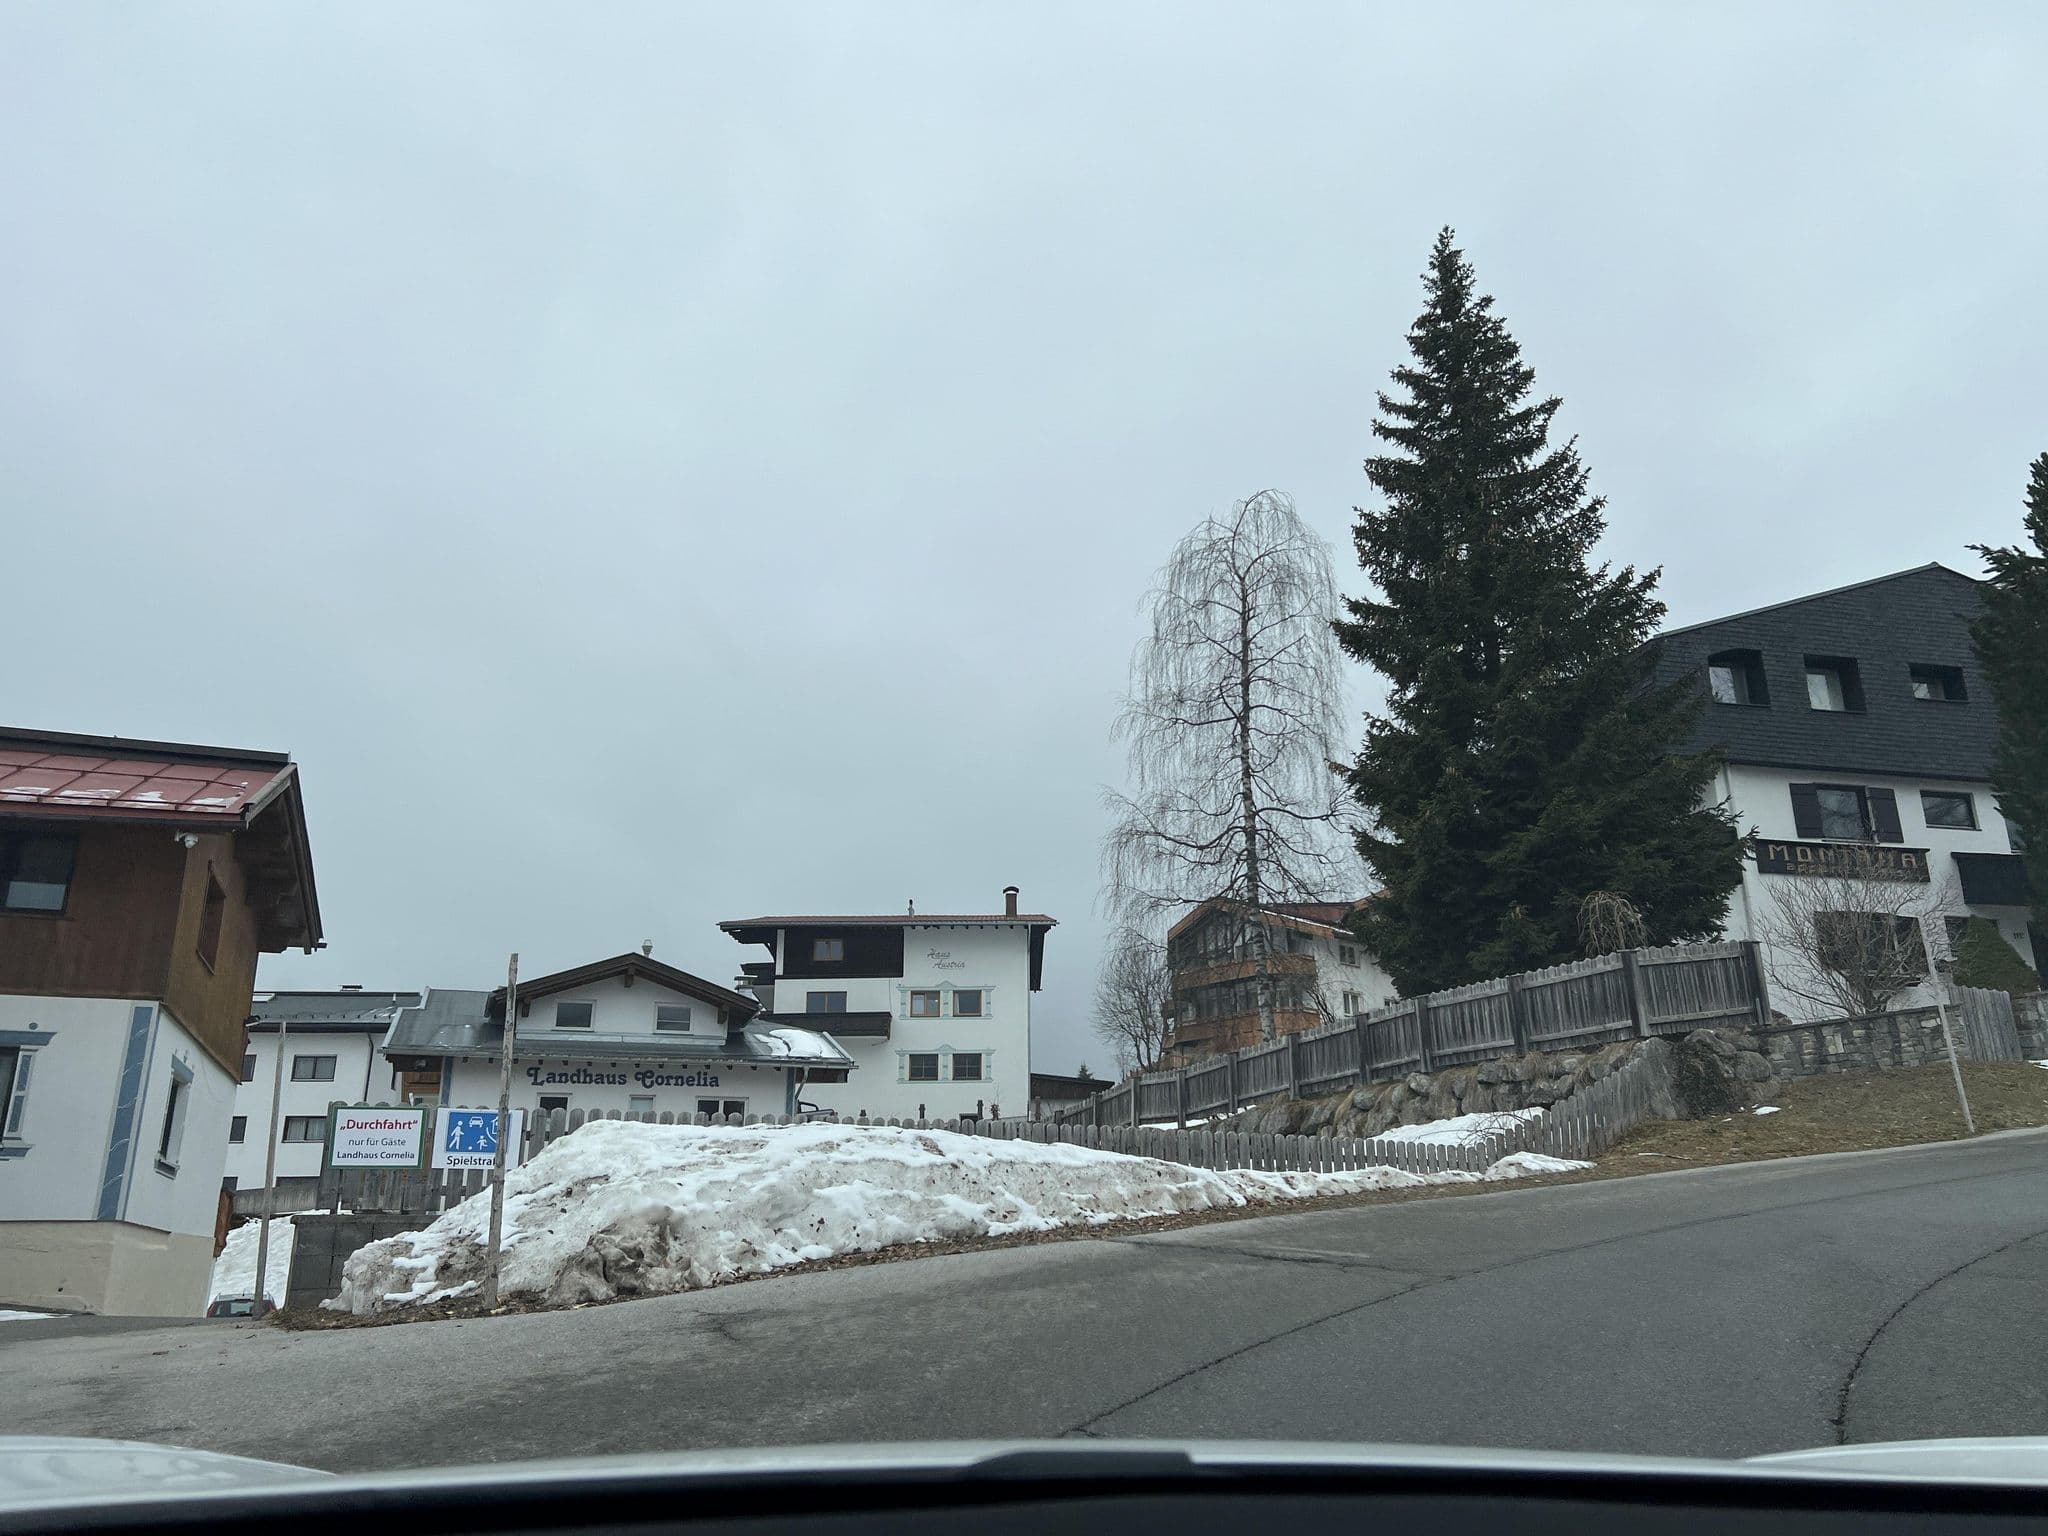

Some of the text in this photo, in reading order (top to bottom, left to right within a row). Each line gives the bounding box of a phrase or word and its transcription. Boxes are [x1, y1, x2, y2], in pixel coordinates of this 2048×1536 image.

[526, 1067, 720, 1089] Landhaus Cornelia
[366, 1138, 379, 1146] für
[381, 1138, 407, 1146] Gäste
[337, 1151, 415, 1159] Landhaus Cornelia
[446, 1155, 497, 1167] Spielstra
